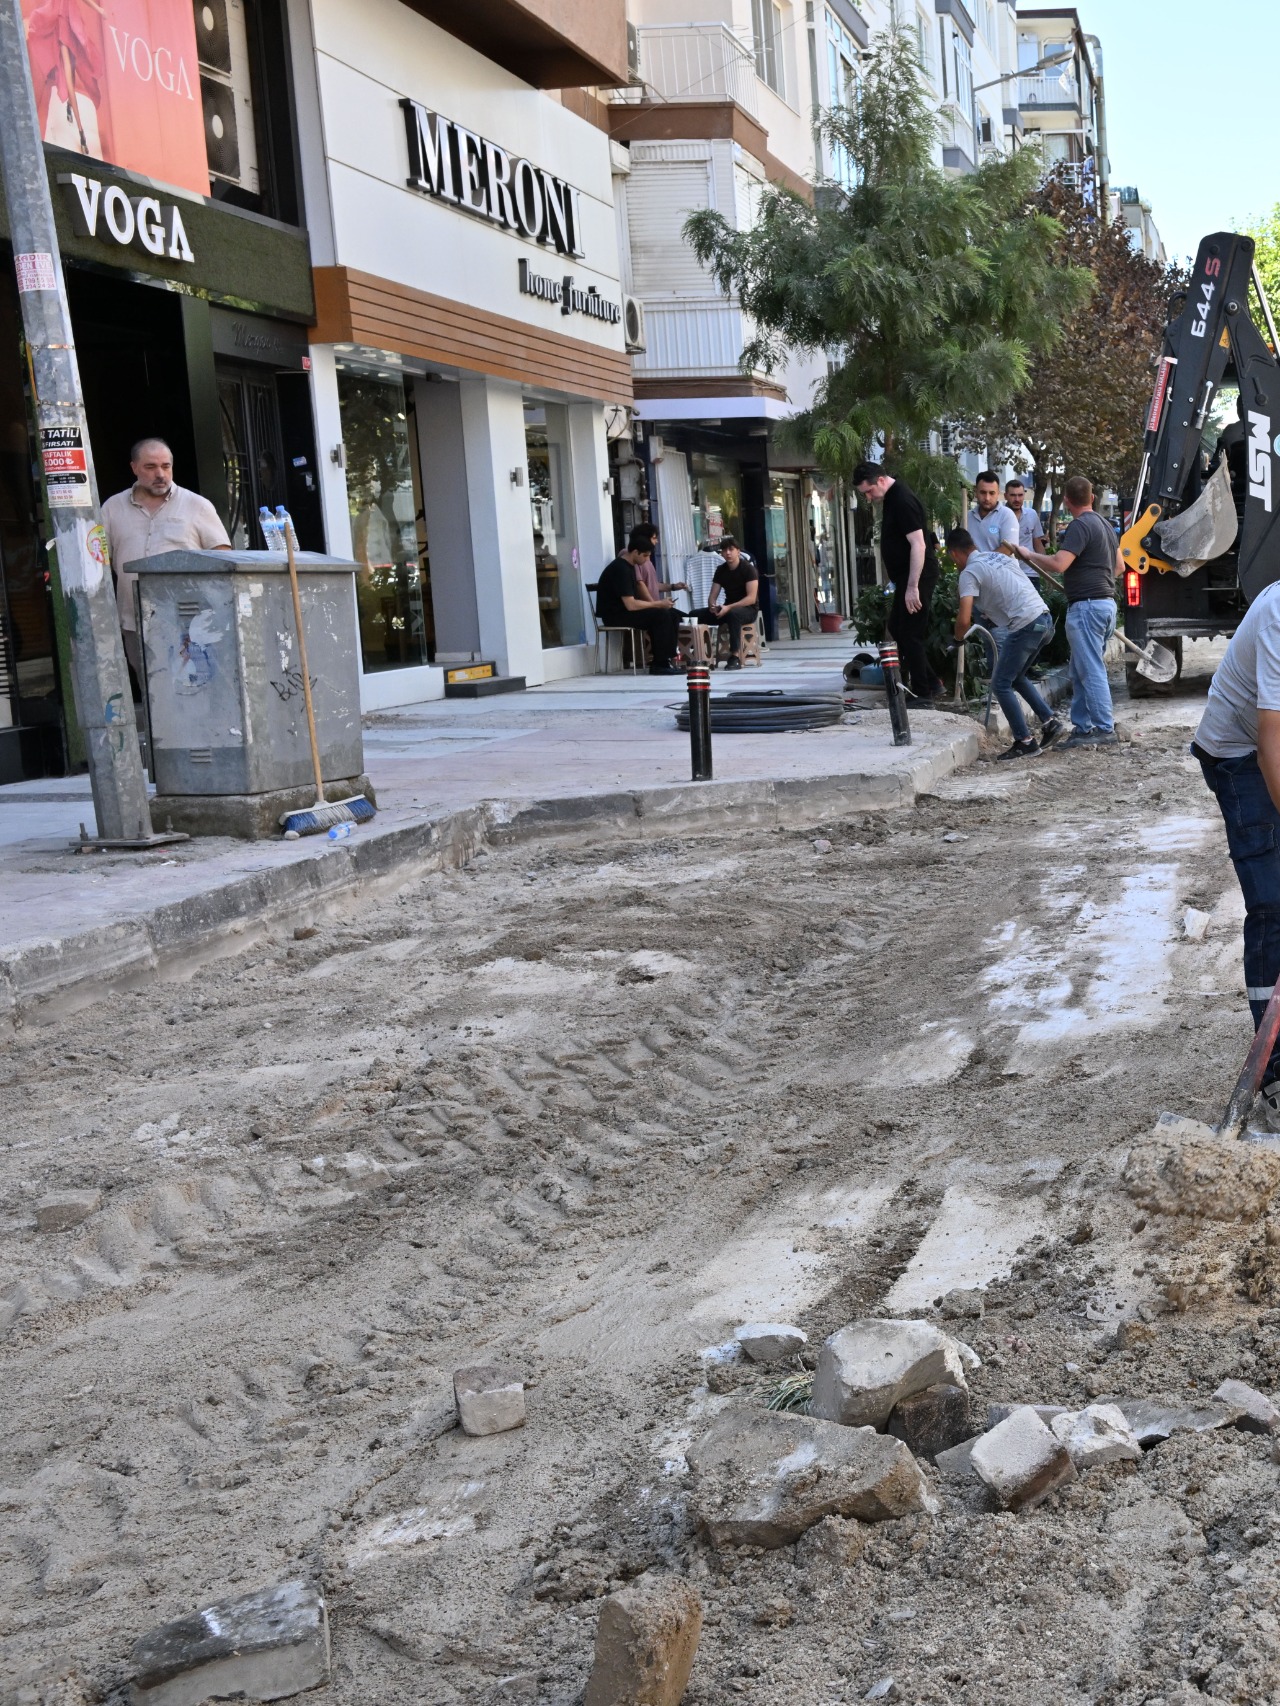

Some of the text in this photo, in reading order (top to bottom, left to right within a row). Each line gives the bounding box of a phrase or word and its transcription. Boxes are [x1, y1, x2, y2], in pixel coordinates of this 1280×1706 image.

[109, 25, 195, 101] VOGA
[66, 173, 195, 263] VOGA
[402, 99, 586, 259] MERONI
[518, 257, 620, 325] home furniture
[1190, 281, 1216, 338] 644
[1247, 409, 1272, 513] MST
